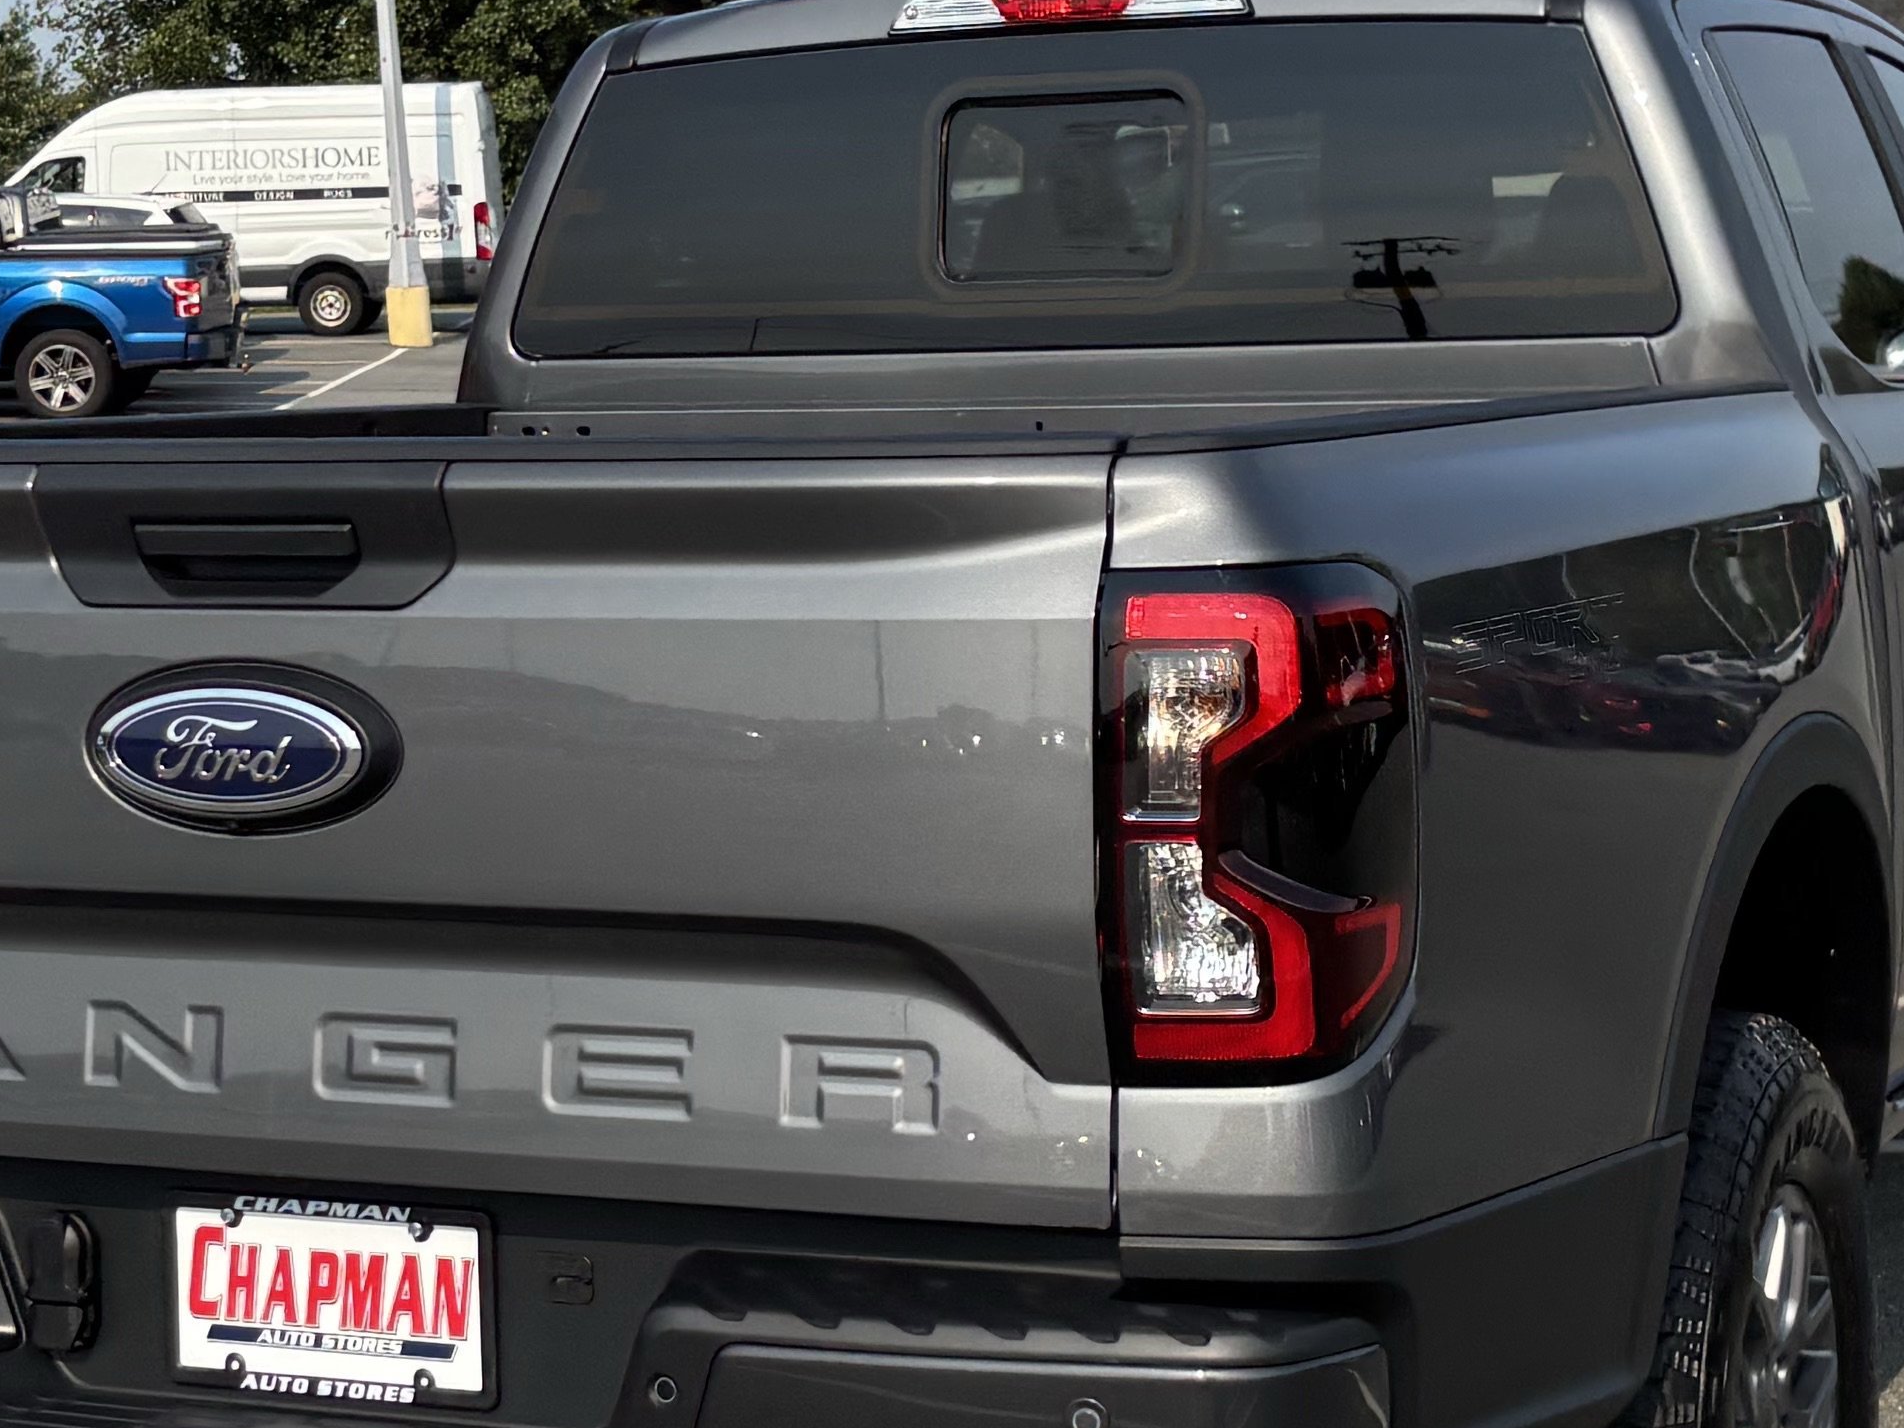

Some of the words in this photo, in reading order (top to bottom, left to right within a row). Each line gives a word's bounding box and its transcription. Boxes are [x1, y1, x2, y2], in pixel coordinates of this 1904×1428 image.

[165, 146, 381, 172] INTERIORSHOME
[219, 174, 243, 186] your
[279, 172, 306, 183] Love
[309, 172, 334, 184] your
[153, 714, 293, 784] Ford
[233, 1195, 412, 1223] CHAPMAN
[188, 1222, 475, 1341] CHAPMAN
[256, 1327, 317, 1348] AUTO
[321, 1335, 404, 1356] STORES
[240, 1373, 309, 1395] AUTO
[316, 1380, 416, 1404] STORES
